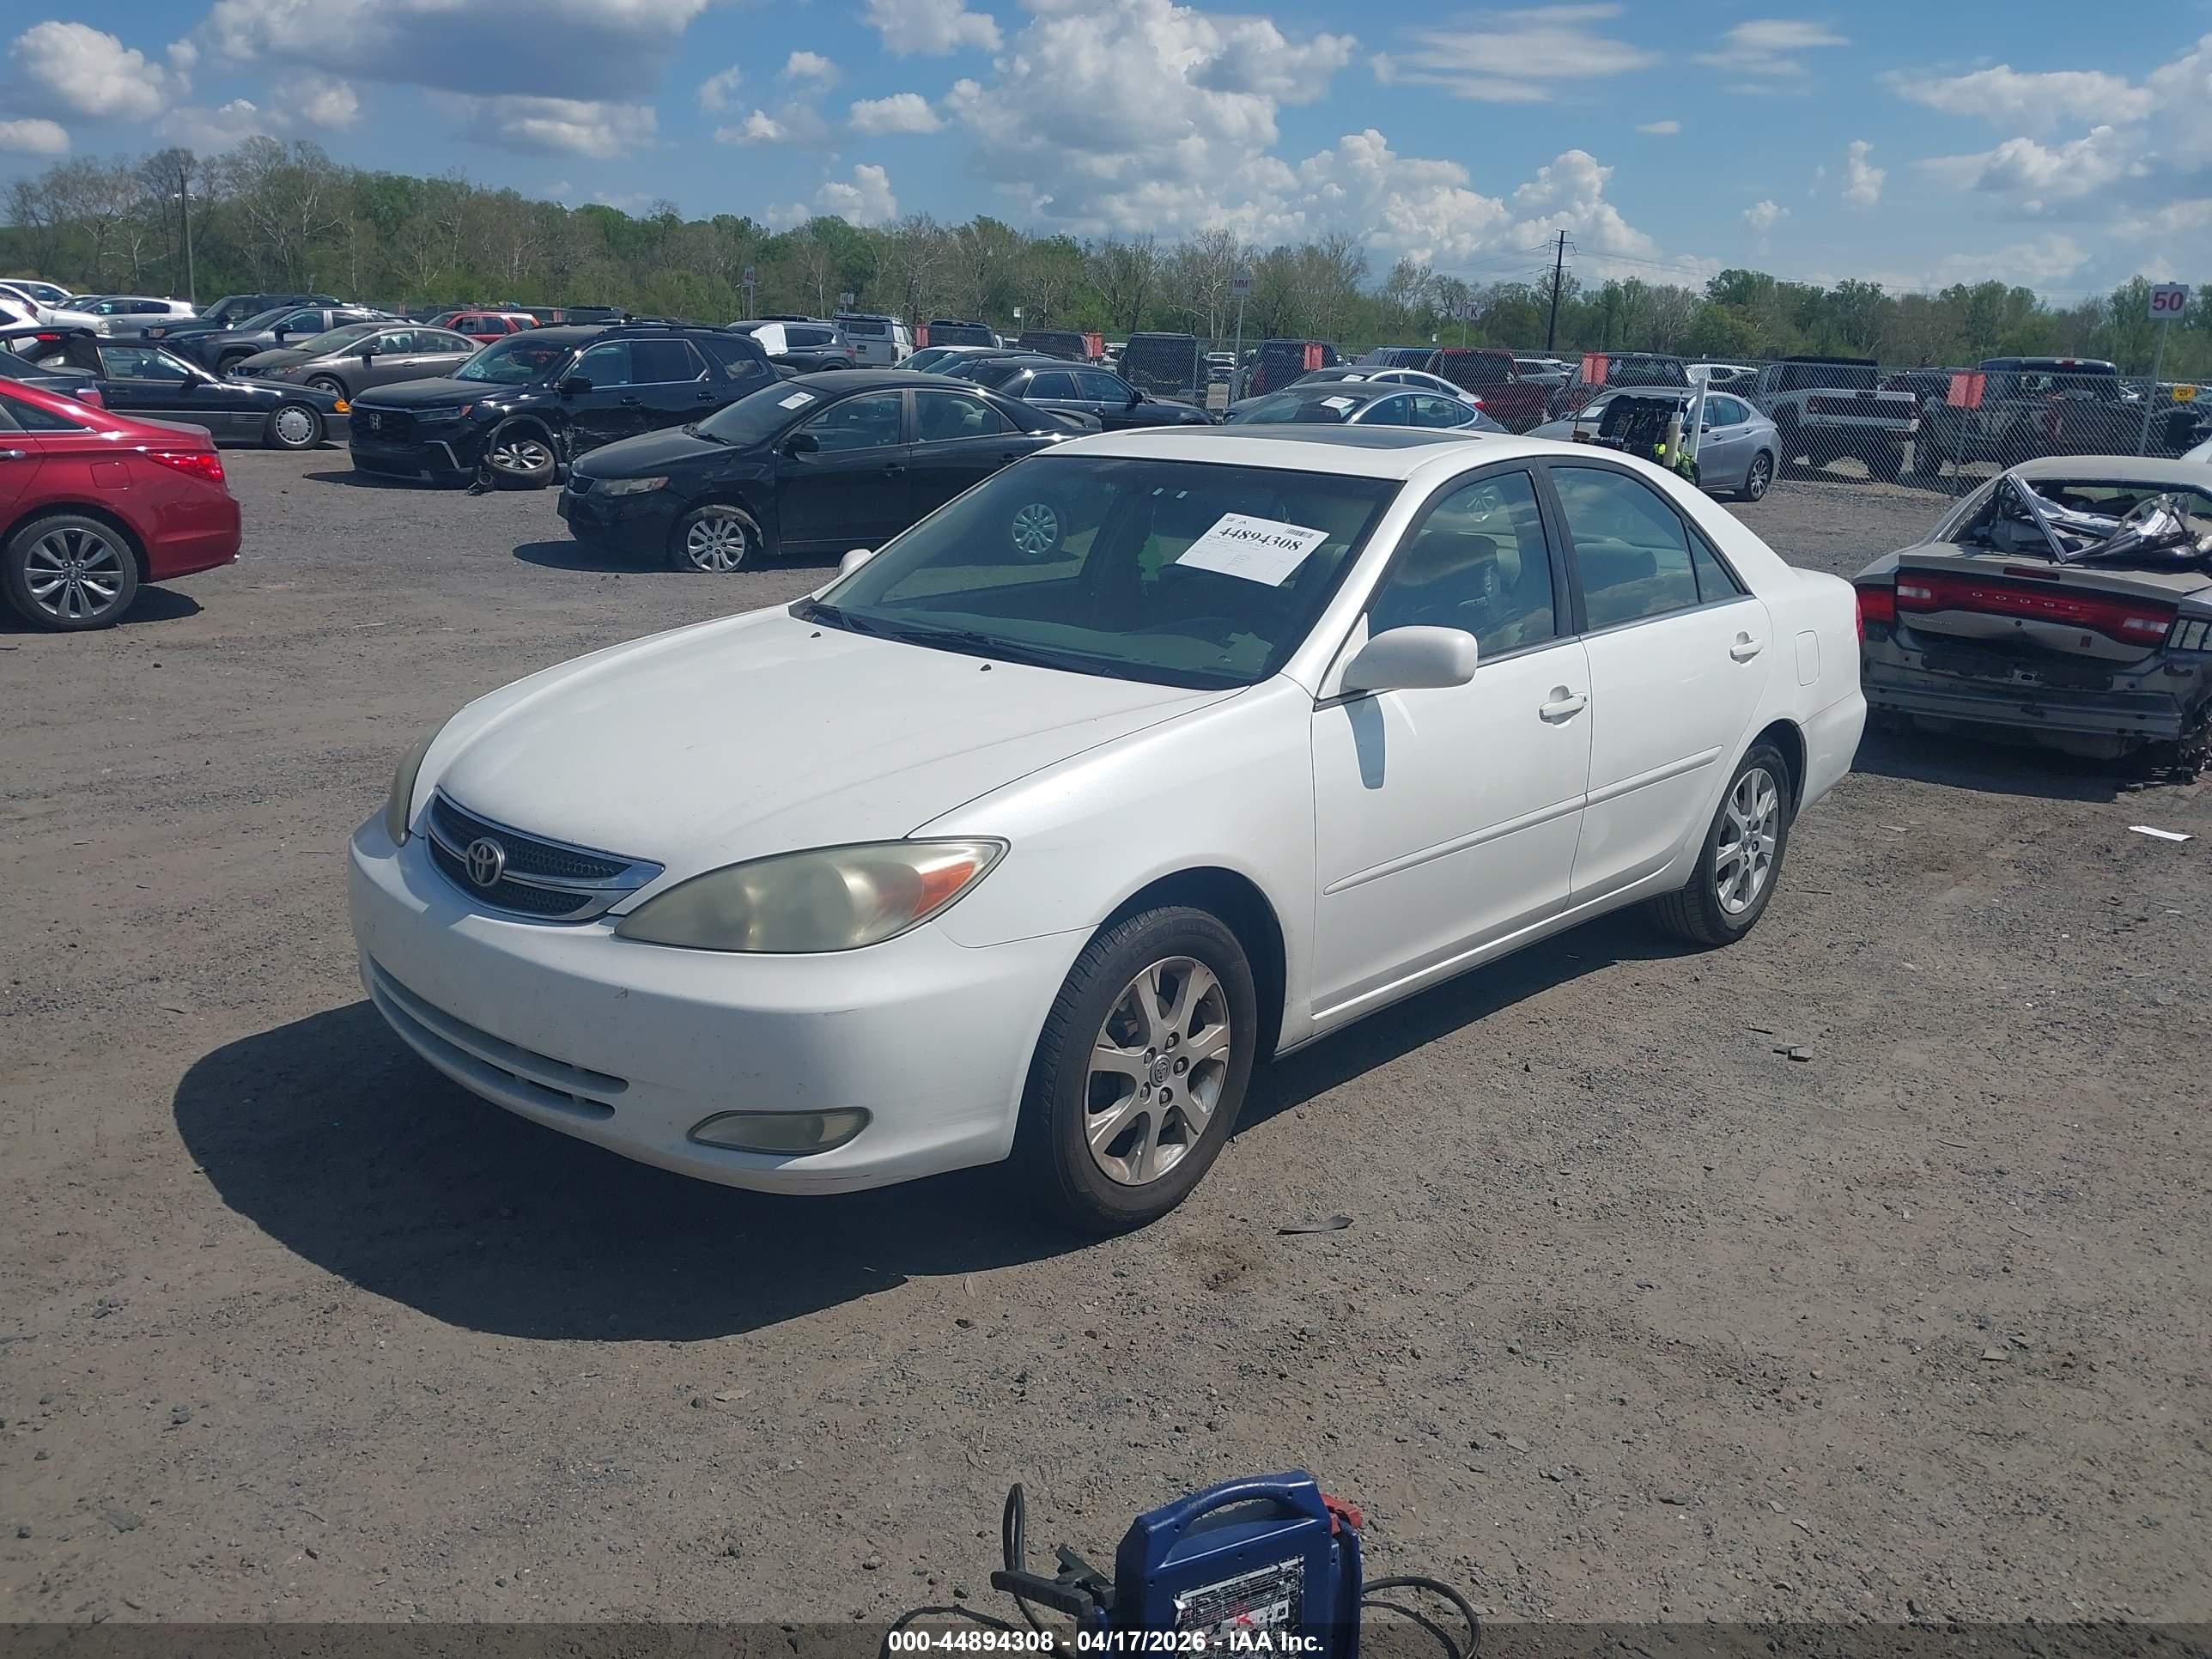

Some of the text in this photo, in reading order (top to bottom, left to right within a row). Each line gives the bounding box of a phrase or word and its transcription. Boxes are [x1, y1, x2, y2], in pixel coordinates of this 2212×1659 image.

[1234, 279, 1249, 289] MM
[2152, 291, 2185, 312] 50
[1455, 307, 1478, 318] J K
[1218, 526, 1304, 552] 44894308
[1972, 592, 2081, 611] DODGE
